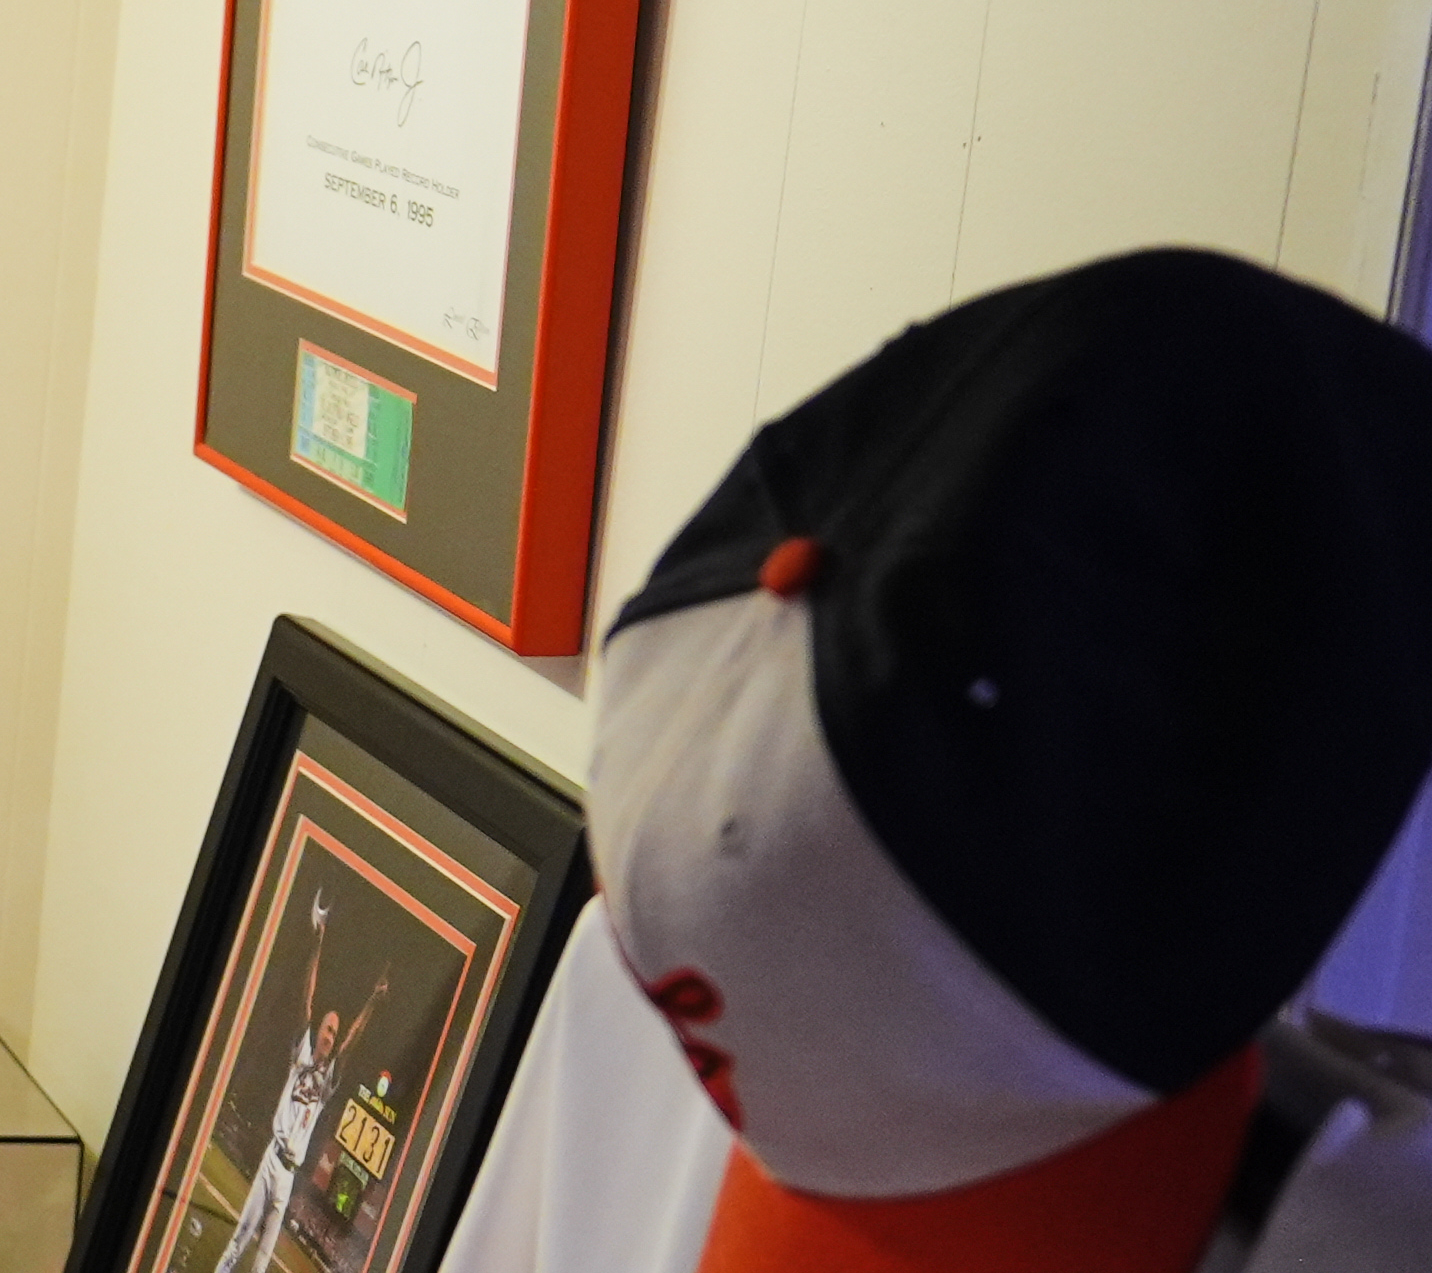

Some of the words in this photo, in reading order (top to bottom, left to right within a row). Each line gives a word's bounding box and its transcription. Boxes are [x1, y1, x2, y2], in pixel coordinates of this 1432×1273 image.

[324, 172, 387, 212] SEPTEMBER
[407, 199, 435, 228] 1995
[339, 1104, 392, 1174] 2131
